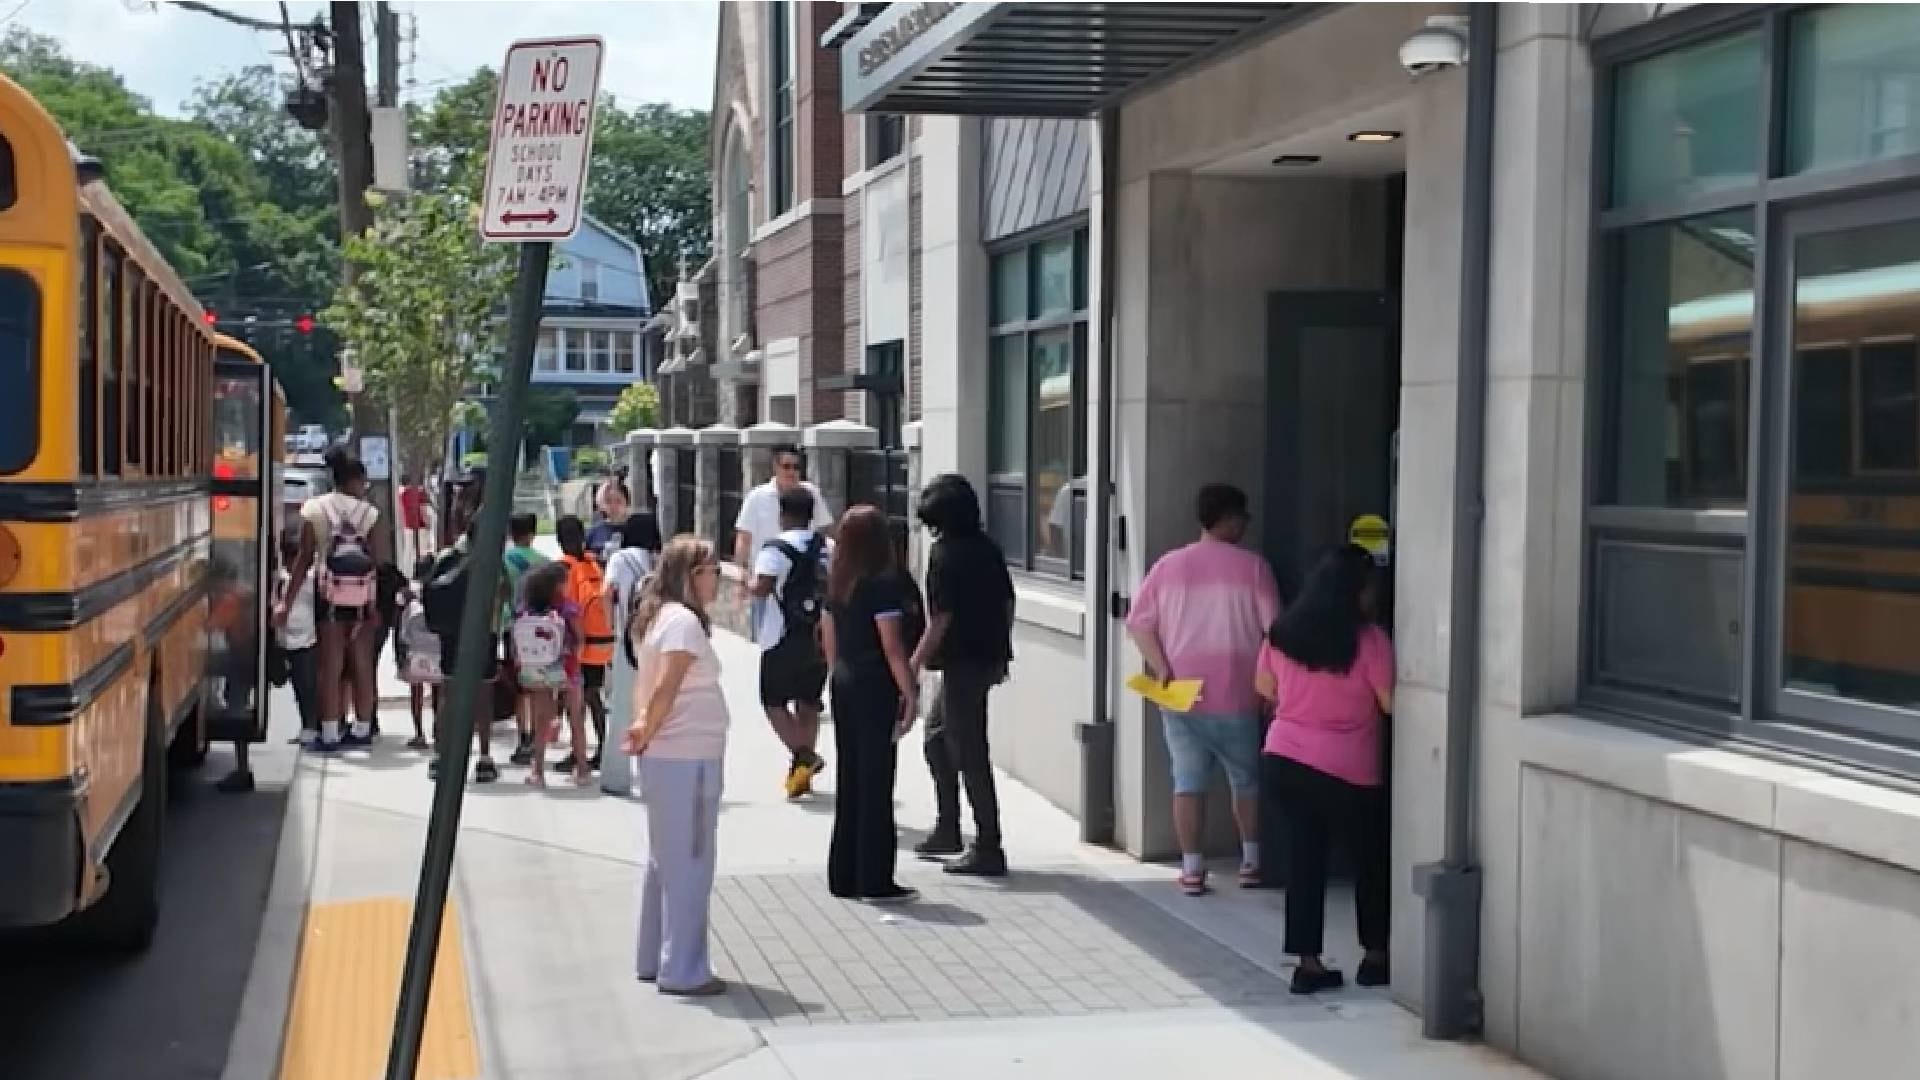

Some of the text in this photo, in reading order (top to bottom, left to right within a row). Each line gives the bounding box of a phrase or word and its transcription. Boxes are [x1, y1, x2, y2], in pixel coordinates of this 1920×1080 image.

[531, 56, 569, 93] NO
[500, 99, 587, 137] PARKING
[511, 143, 562, 163] SCHOOL
[516, 164, 553, 183] DAYS
